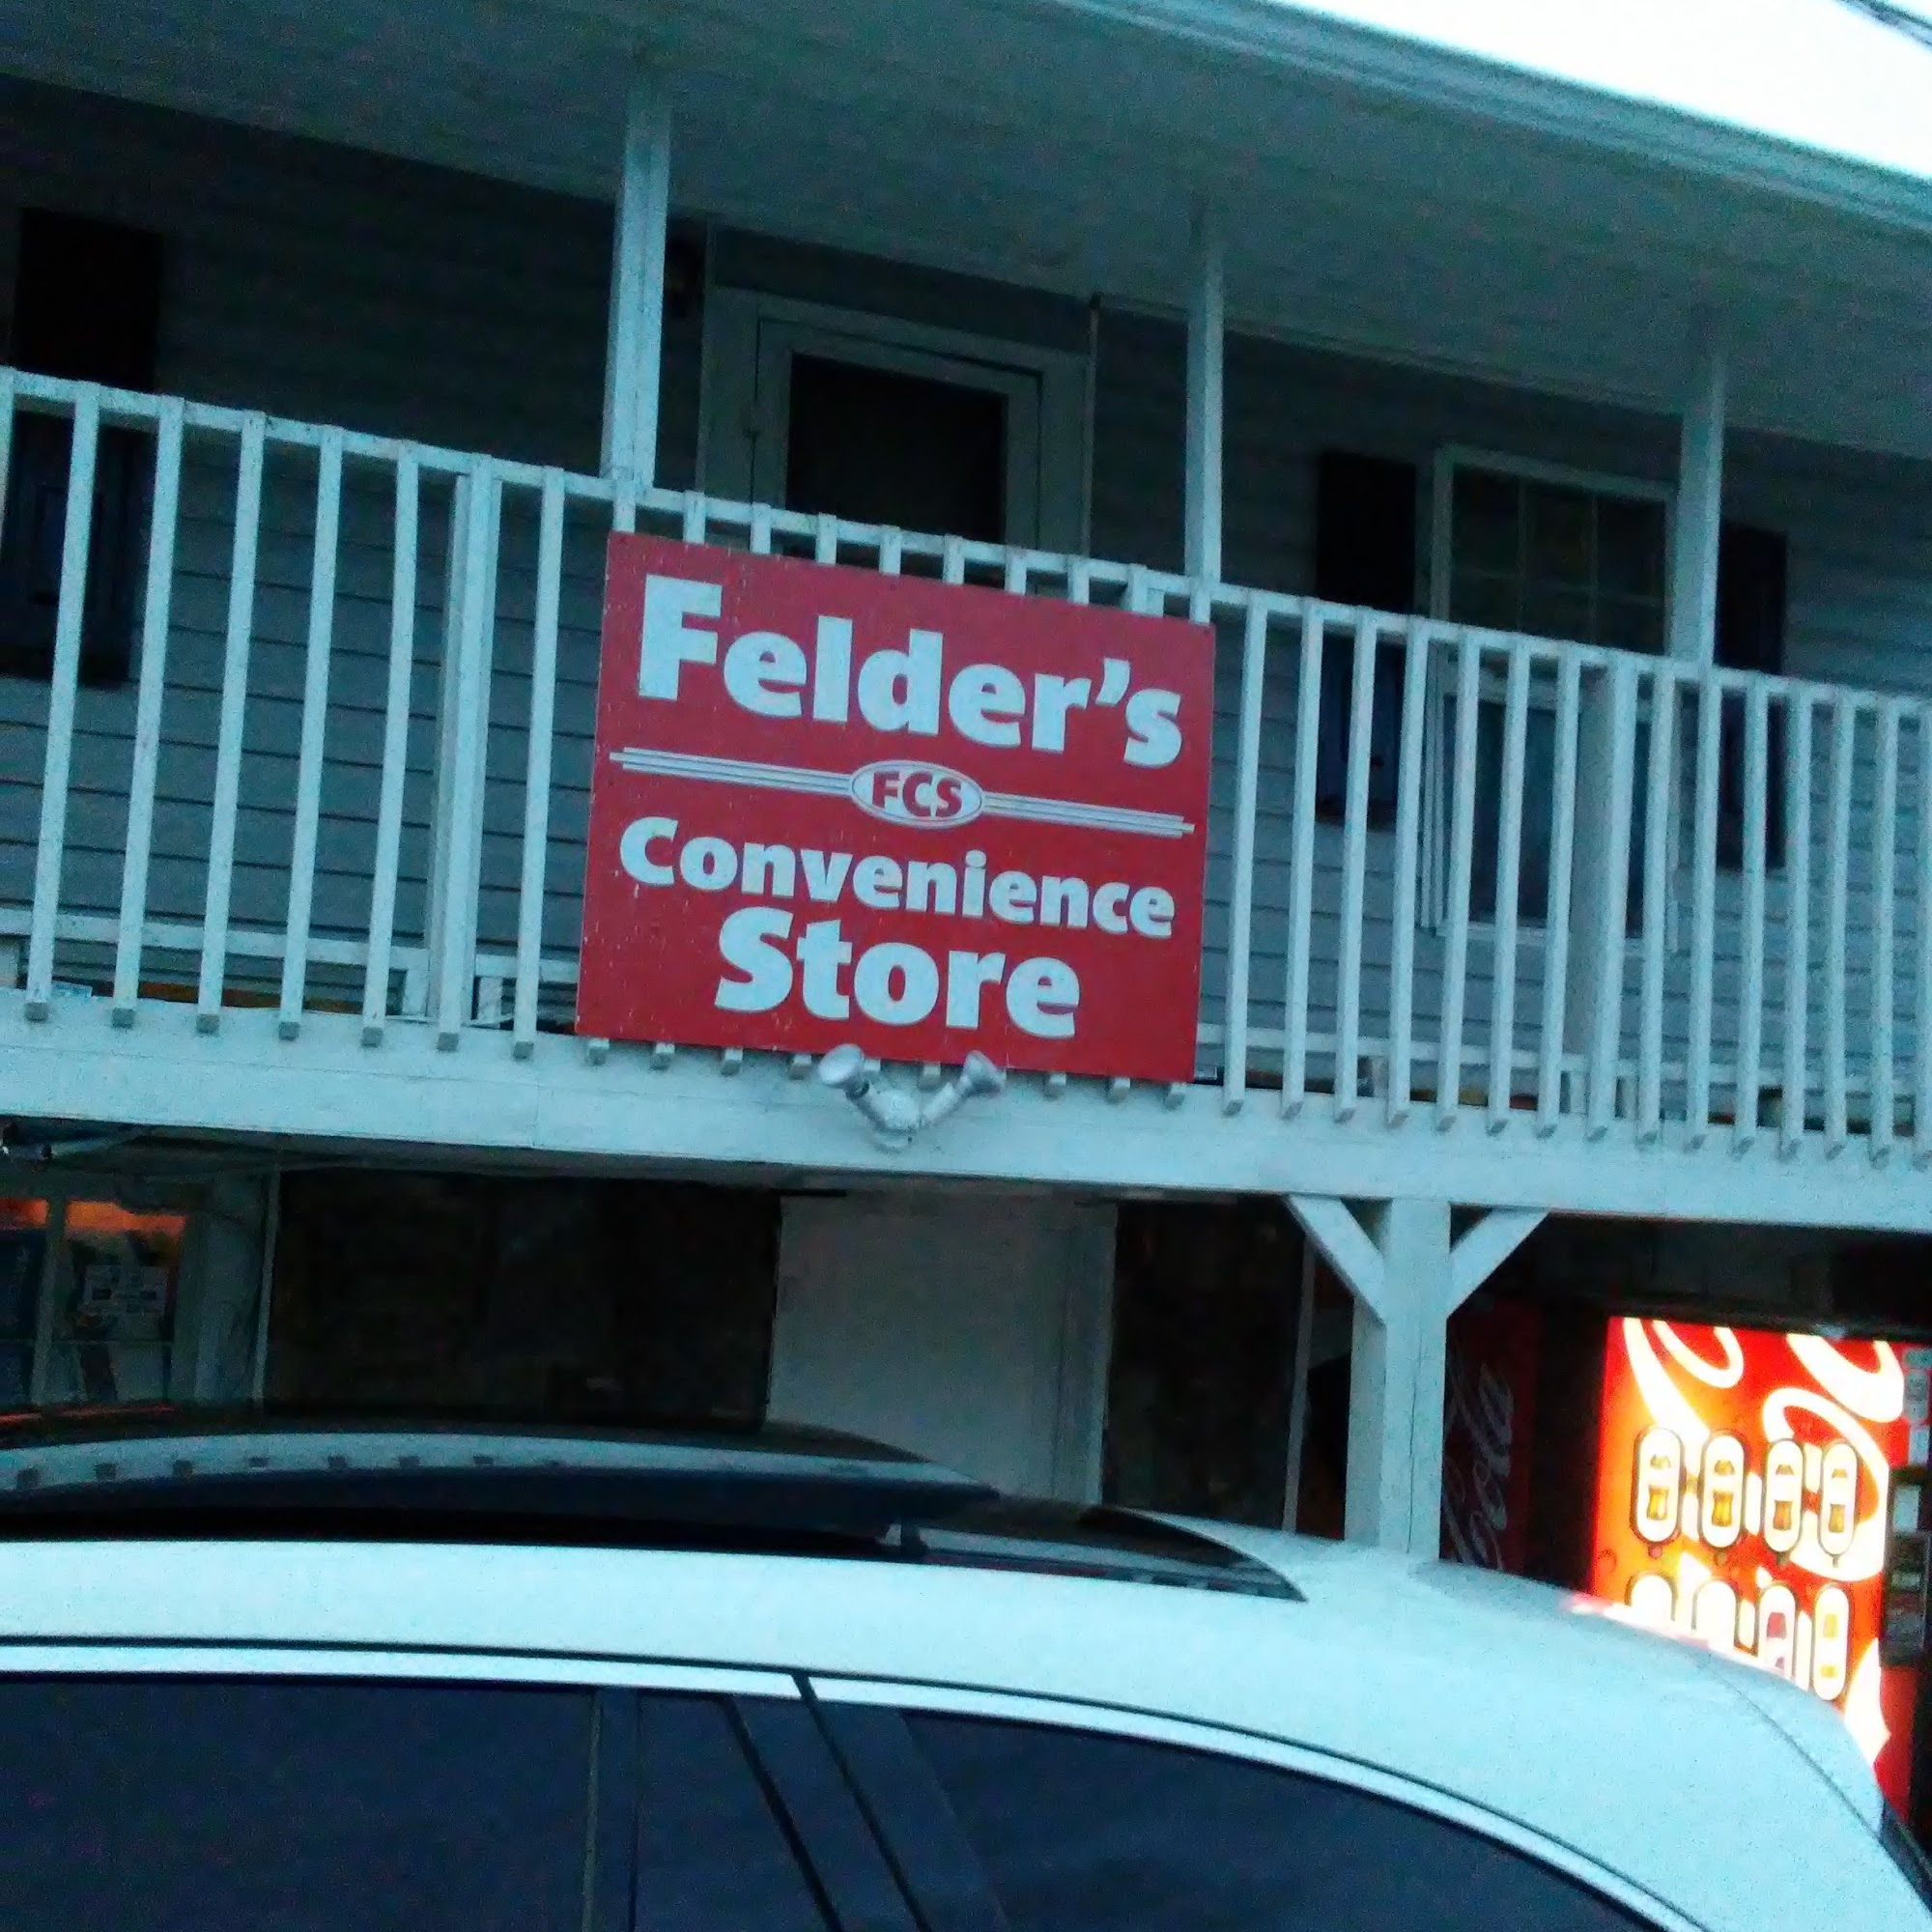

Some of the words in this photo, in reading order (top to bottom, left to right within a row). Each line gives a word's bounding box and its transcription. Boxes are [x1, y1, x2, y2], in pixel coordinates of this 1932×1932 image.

[639, 574, 1182, 767] Felder's
[872, 771, 962, 816] FCS
[619, 817, 1175, 939] Convenience
[714, 907, 1081, 1037] Store
